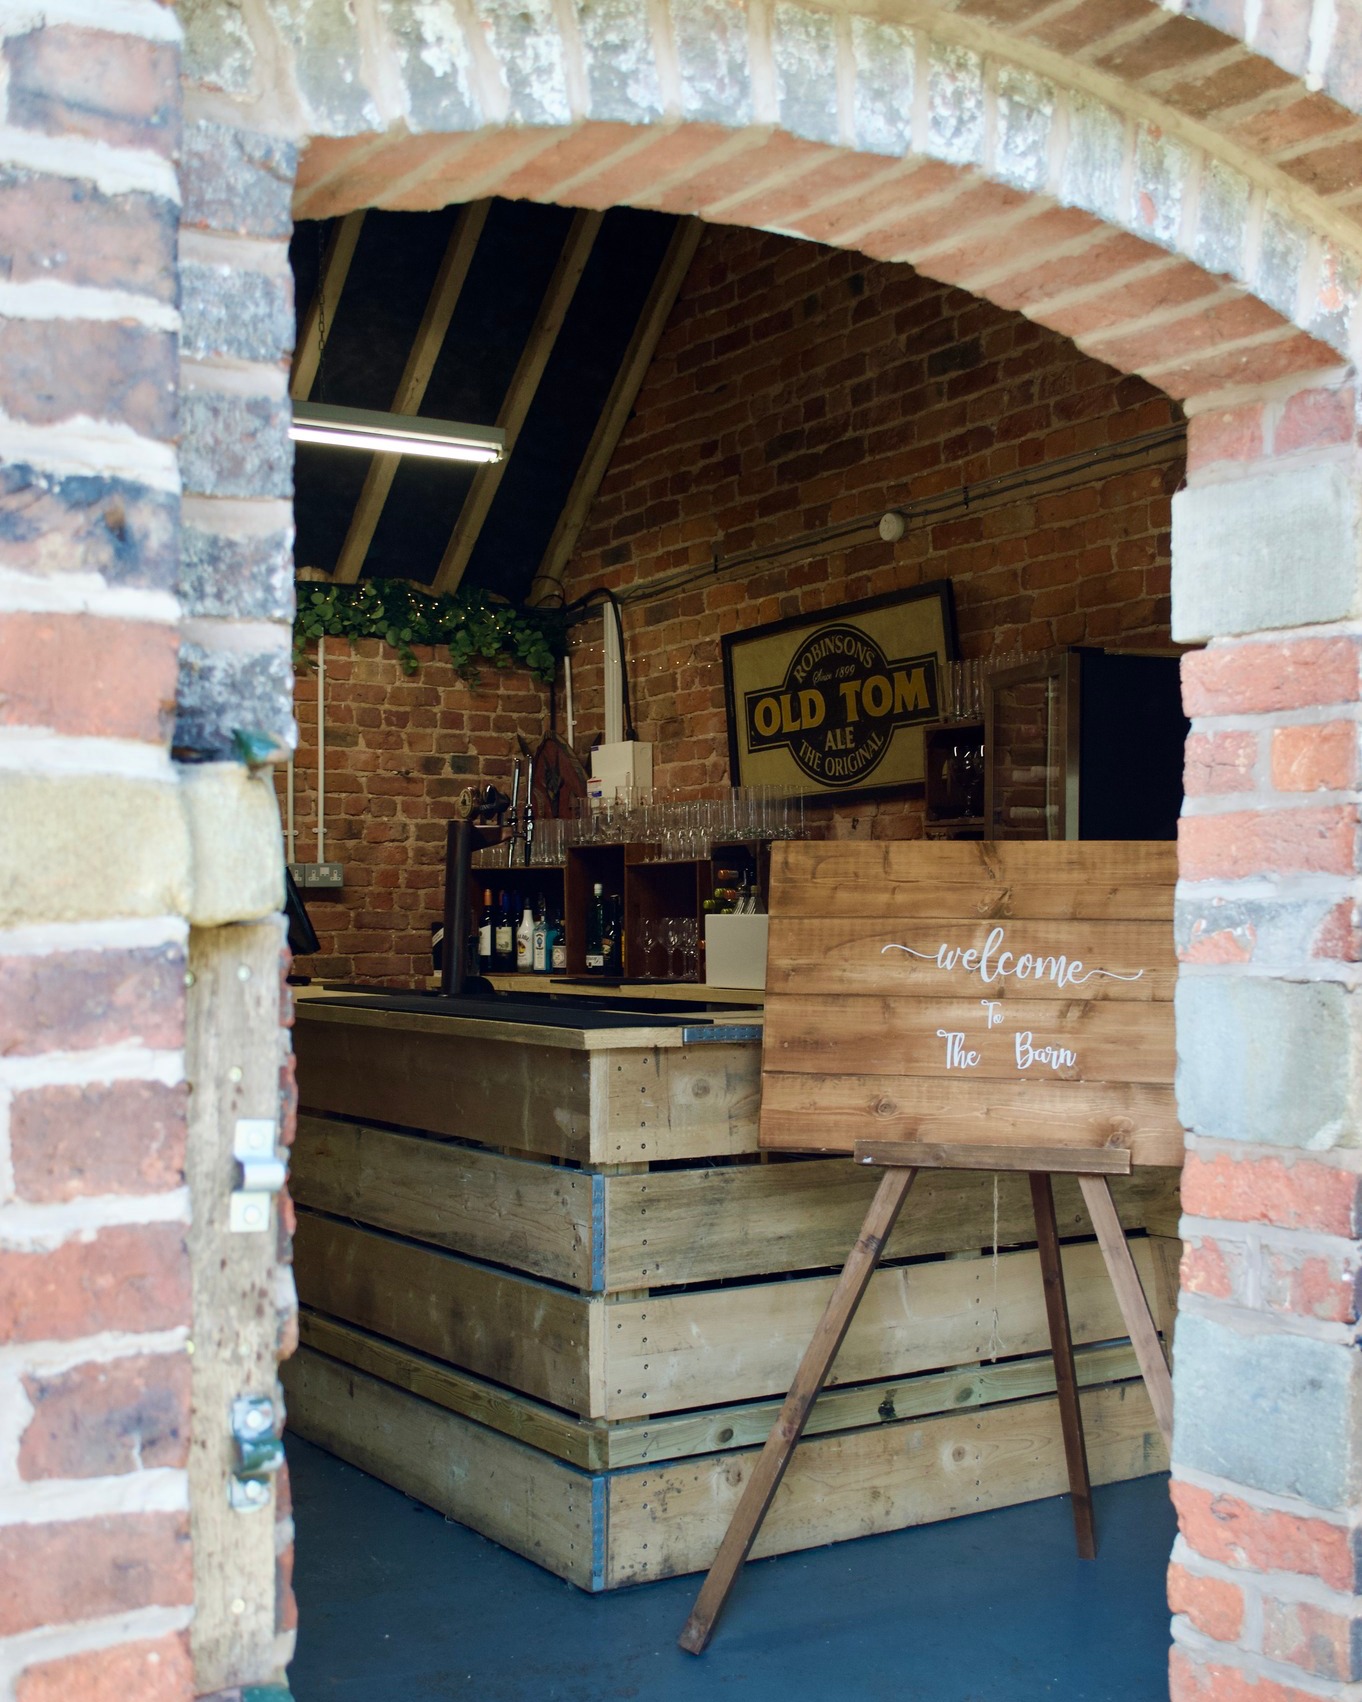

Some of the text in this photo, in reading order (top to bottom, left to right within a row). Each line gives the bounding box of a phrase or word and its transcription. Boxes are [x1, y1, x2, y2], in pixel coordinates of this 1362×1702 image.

[812, 664, 856, 686] Since 1899
[754, 667, 931, 737] OLD TOM
[799, 730, 884, 776] THE ORIGINAL
[824, 726, 856, 752] ALE
[881, 927, 1144, 988] welcome
[980, 999, 1004, 1029] To
[936, 1029, 1076, 1070] The Barn
